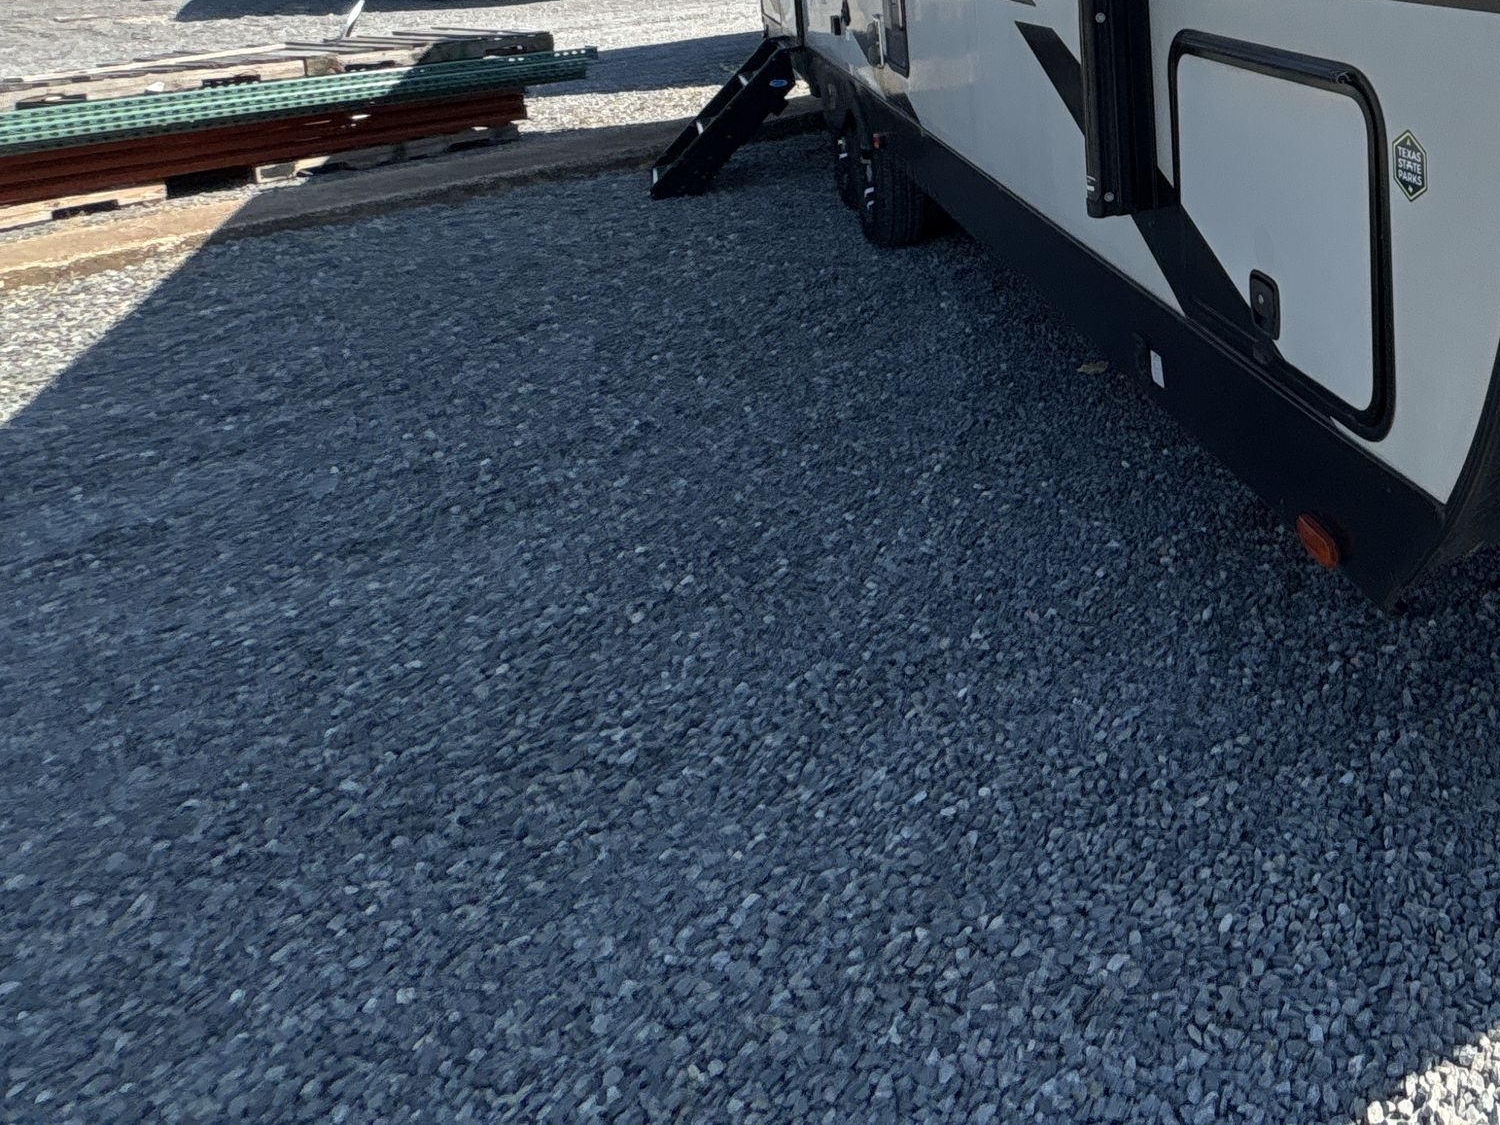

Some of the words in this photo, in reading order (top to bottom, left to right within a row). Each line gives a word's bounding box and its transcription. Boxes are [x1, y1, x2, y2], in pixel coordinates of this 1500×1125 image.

[1397, 145, 1422, 163] TEXAS
[1398, 157, 1422, 175] STATE
[1397, 168, 1423, 186] PARKS
